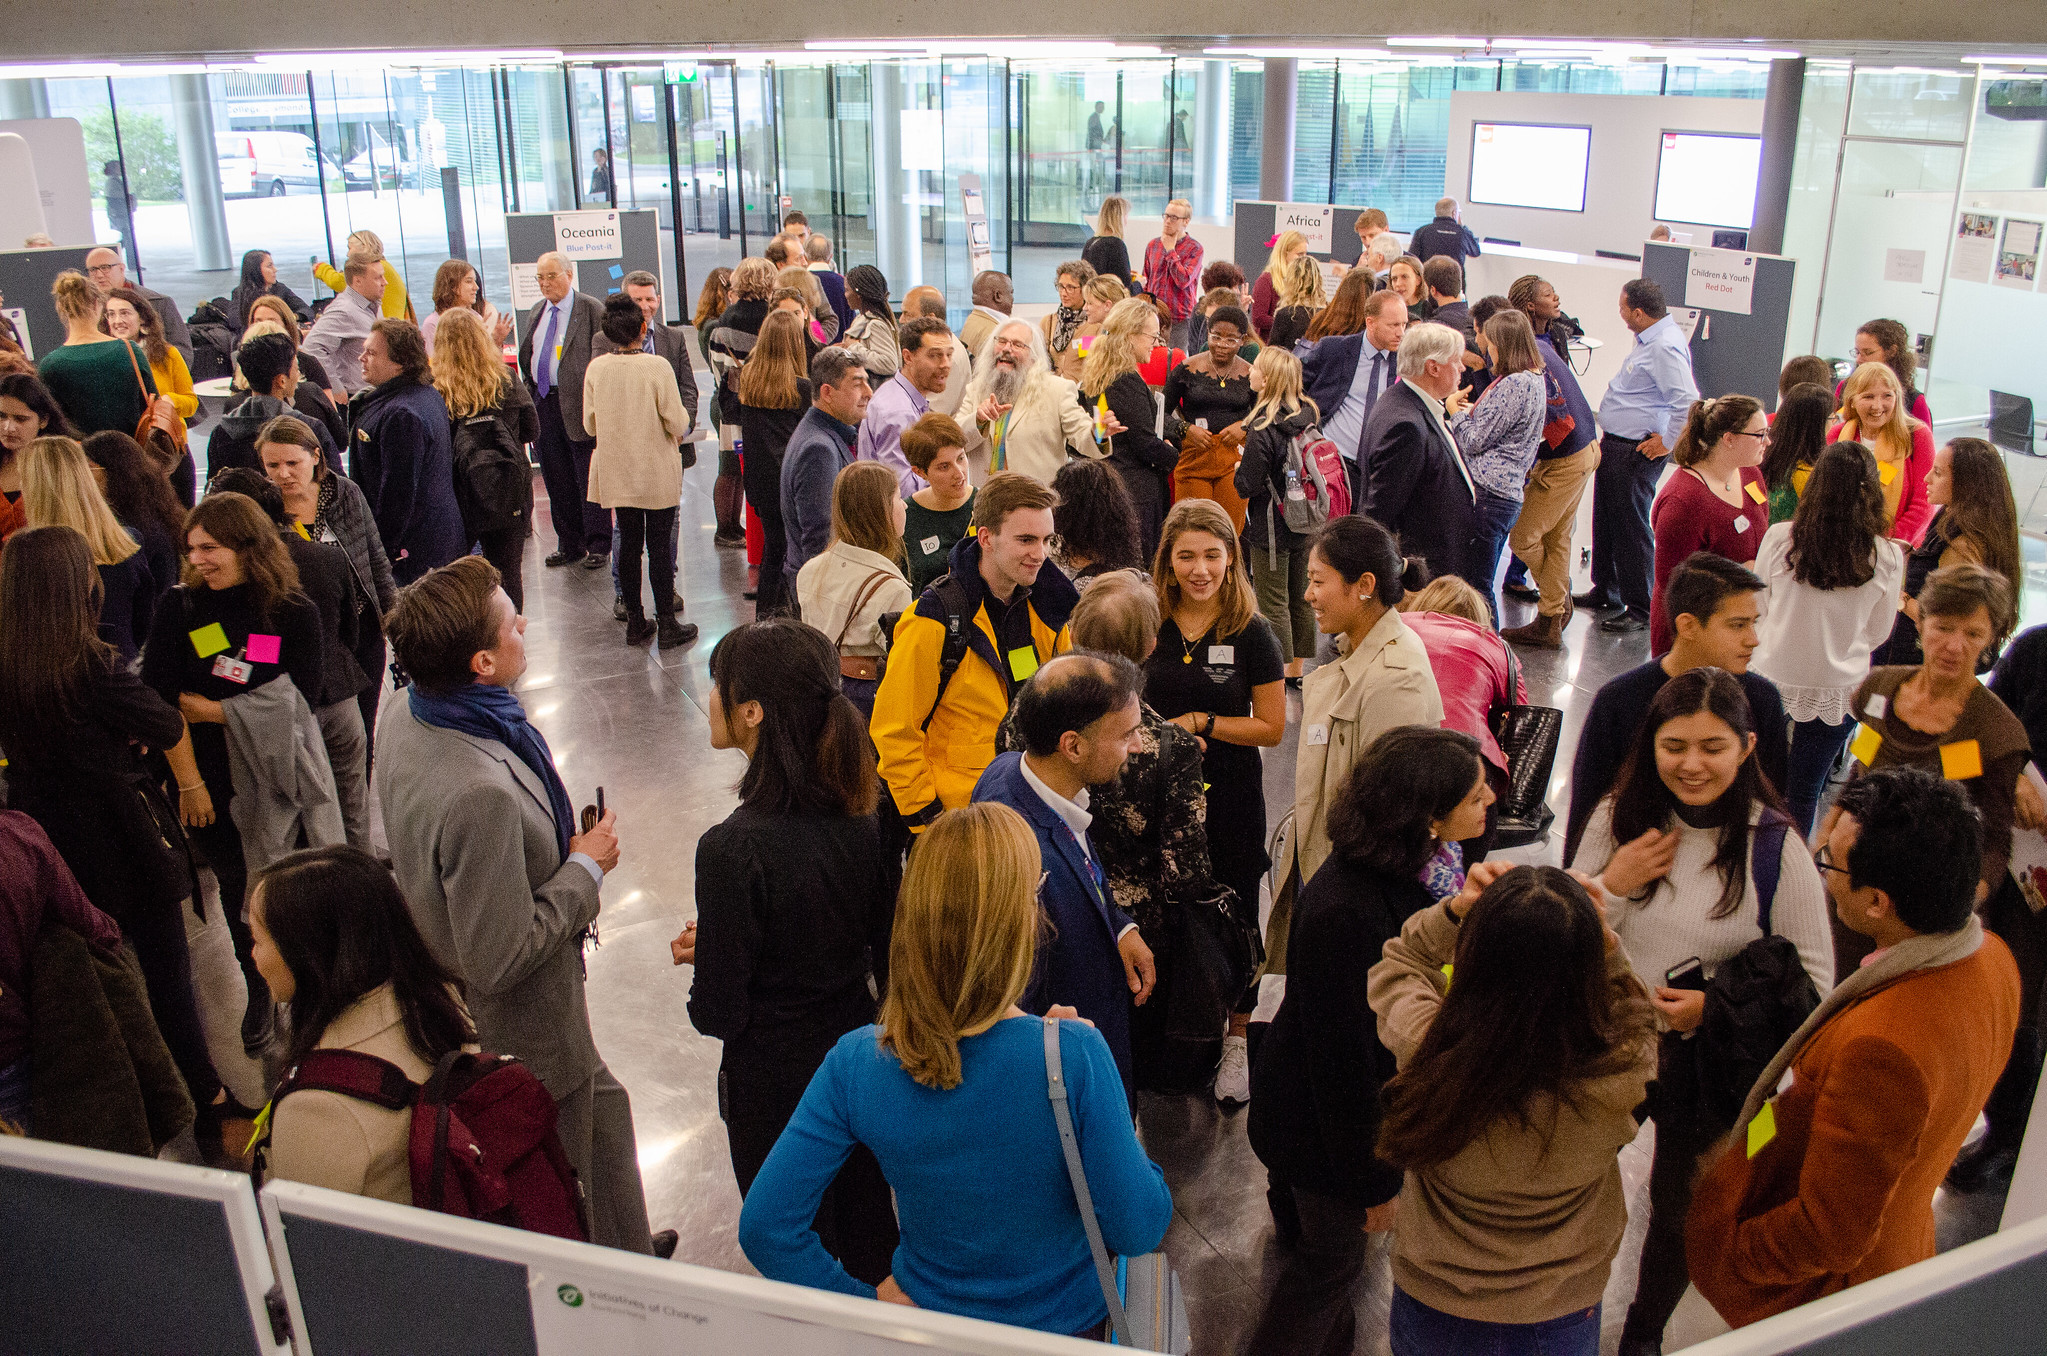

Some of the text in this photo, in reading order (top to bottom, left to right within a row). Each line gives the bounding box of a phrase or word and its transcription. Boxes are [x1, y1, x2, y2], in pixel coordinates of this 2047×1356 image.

[1286, 214, 1321, 227] Africa
[561, 226, 615, 238] Oceania
[566, 243, 612, 252] Blue Post-it
[1691, 268, 1750, 283] Children & Youth
[1705, 282, 1733, 293] Red Dot
[1216, 649, 1226, 660] A
[1314, 729, 1322, 741] A
[589, 1290, 708, 1325] Initiatives of Change
